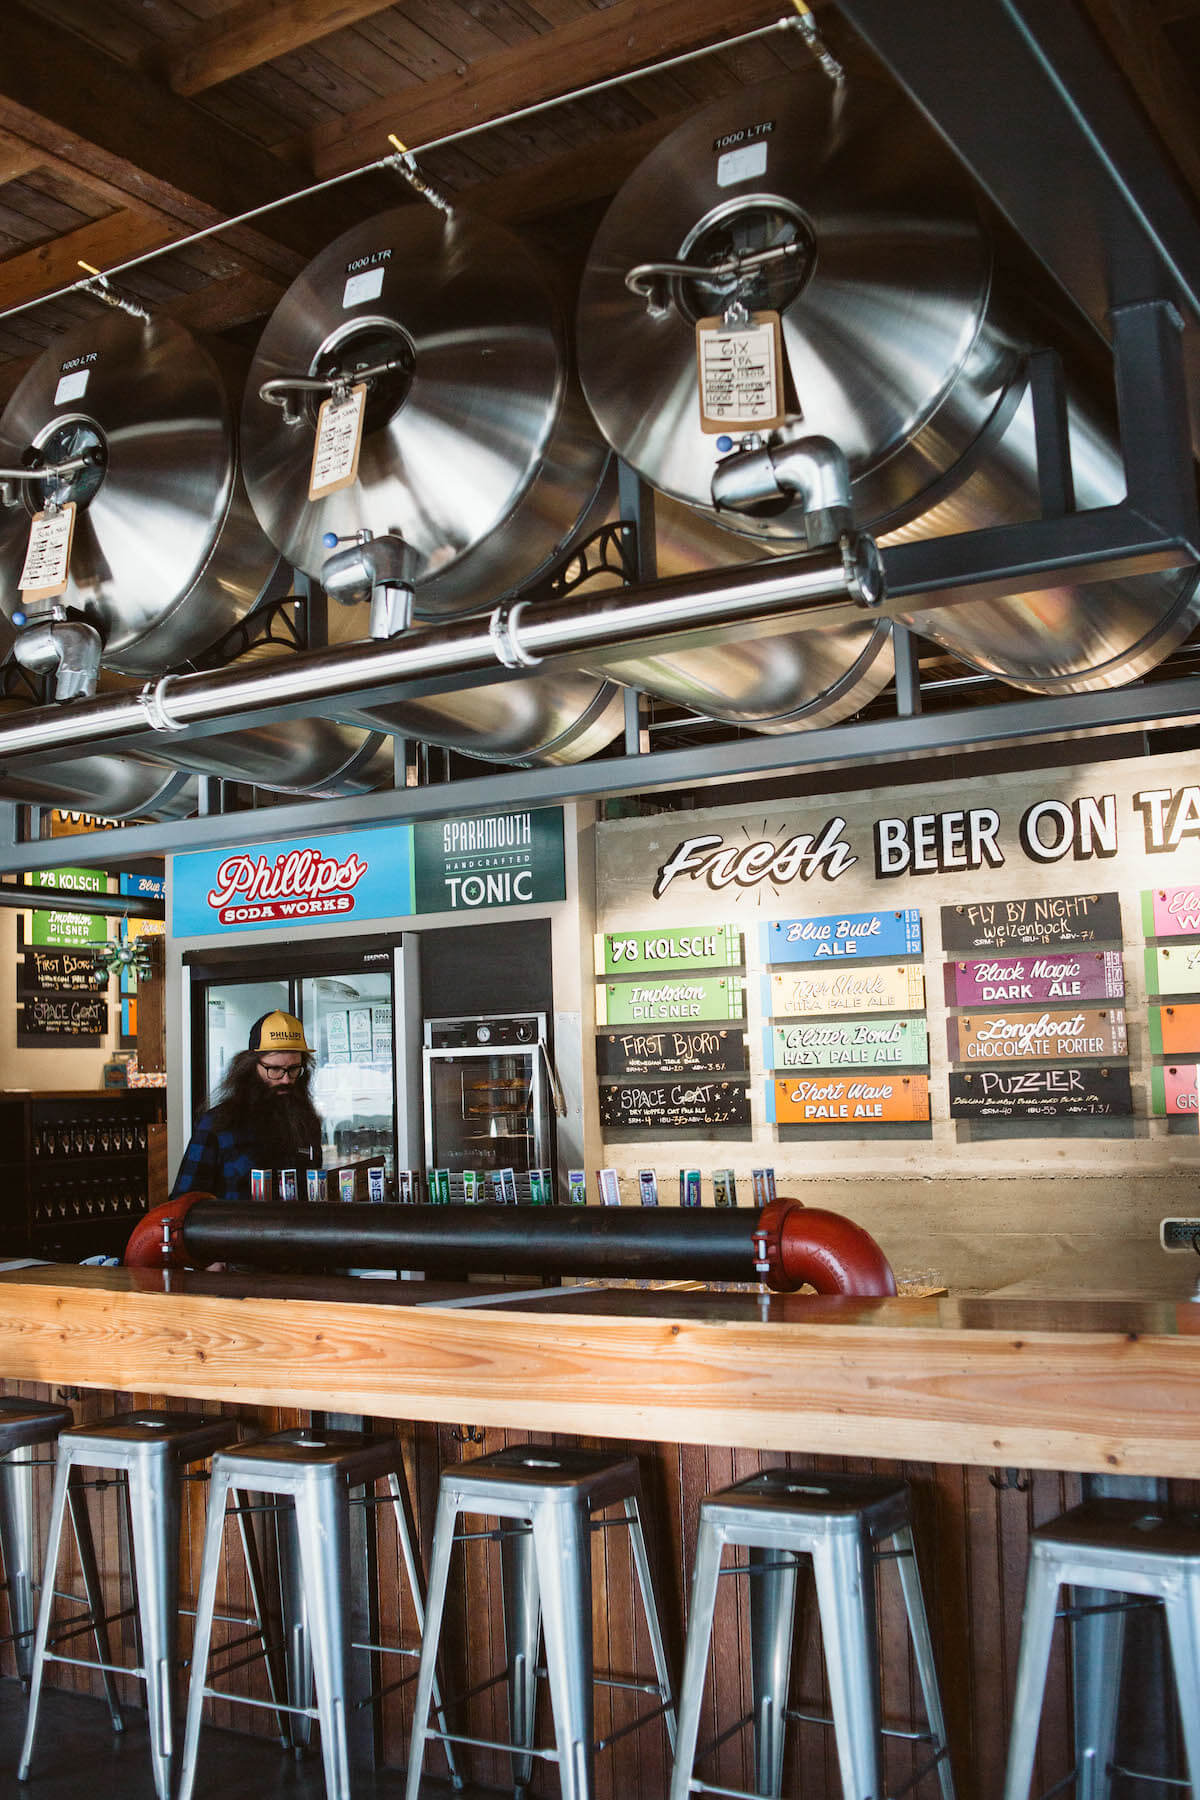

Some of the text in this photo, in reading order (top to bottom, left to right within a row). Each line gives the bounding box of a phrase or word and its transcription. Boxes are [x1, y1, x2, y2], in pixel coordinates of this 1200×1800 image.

[716, 122, 773, 148] 1000 LTR
[347, 249, 392, 271] 1000 LTR
[80, 352, 98, 364] LTR
[443, 813, 532, 853] SPARKMOUTH
[655, 817, 858, 897] Fresh
[876, 808, 1003, 877] BEER
[1021, 795, 1117, 862] ON
[446, 855, 530, 870] HANDCRAFTED
[59, 874, 99, 892] KOLSCH
[208, 849, 368, 909] Phillips
[445, 871, 533, 907] TONIC
[224, 897, 350, 922] SODA WORKS
[967, 904, 996, 926] FLY
[1006, 901, 1027, 923] BY
[50, 924, 90, 936] PILSNER
[786, 922, 831, 942] Blue
[835, 916, 881, 938] Buck
[644, 936, 717, 960] KOLSCH
[814, 940, 857, 957] ALE
[973, 962, 1025, 983] Black
[1029, 958, 1081, 982] Magic
[628, 984, 707, 1005] Implosion
[832, 975, 885, 996] Shark
[982, 984, 1033, 1000] DARK
[1048, 981, 1081, 997] ALE
[34, 1003, 69, 1020] SPACE
[633, 1004, 701, 1018] PILSNER
[828, 997, 862, 1010] PALE
[867, 995, 897, 1007] ALE
[786, 1028, 850, 1049] Glitter
[851, 1023, 902, 1045] Bomb
[976, 1013, 1086, 1049] Longboat
[783, 1048, 904, 1065] HAZY PALE ALE
[967, 1039, 1050, 1058] CHOCOLATE
[1057, 1038, 1104, 1054] PORTER
[790, 1081, 846, 1102] Short
[846, 1083, 894, 1100] Wave
[980, 1069, 1085, 1095] PUZZLER
[620, 1084, 715, 1109] SPACE GOAT
[804, 1103, 884, 1118] PALE ALE
